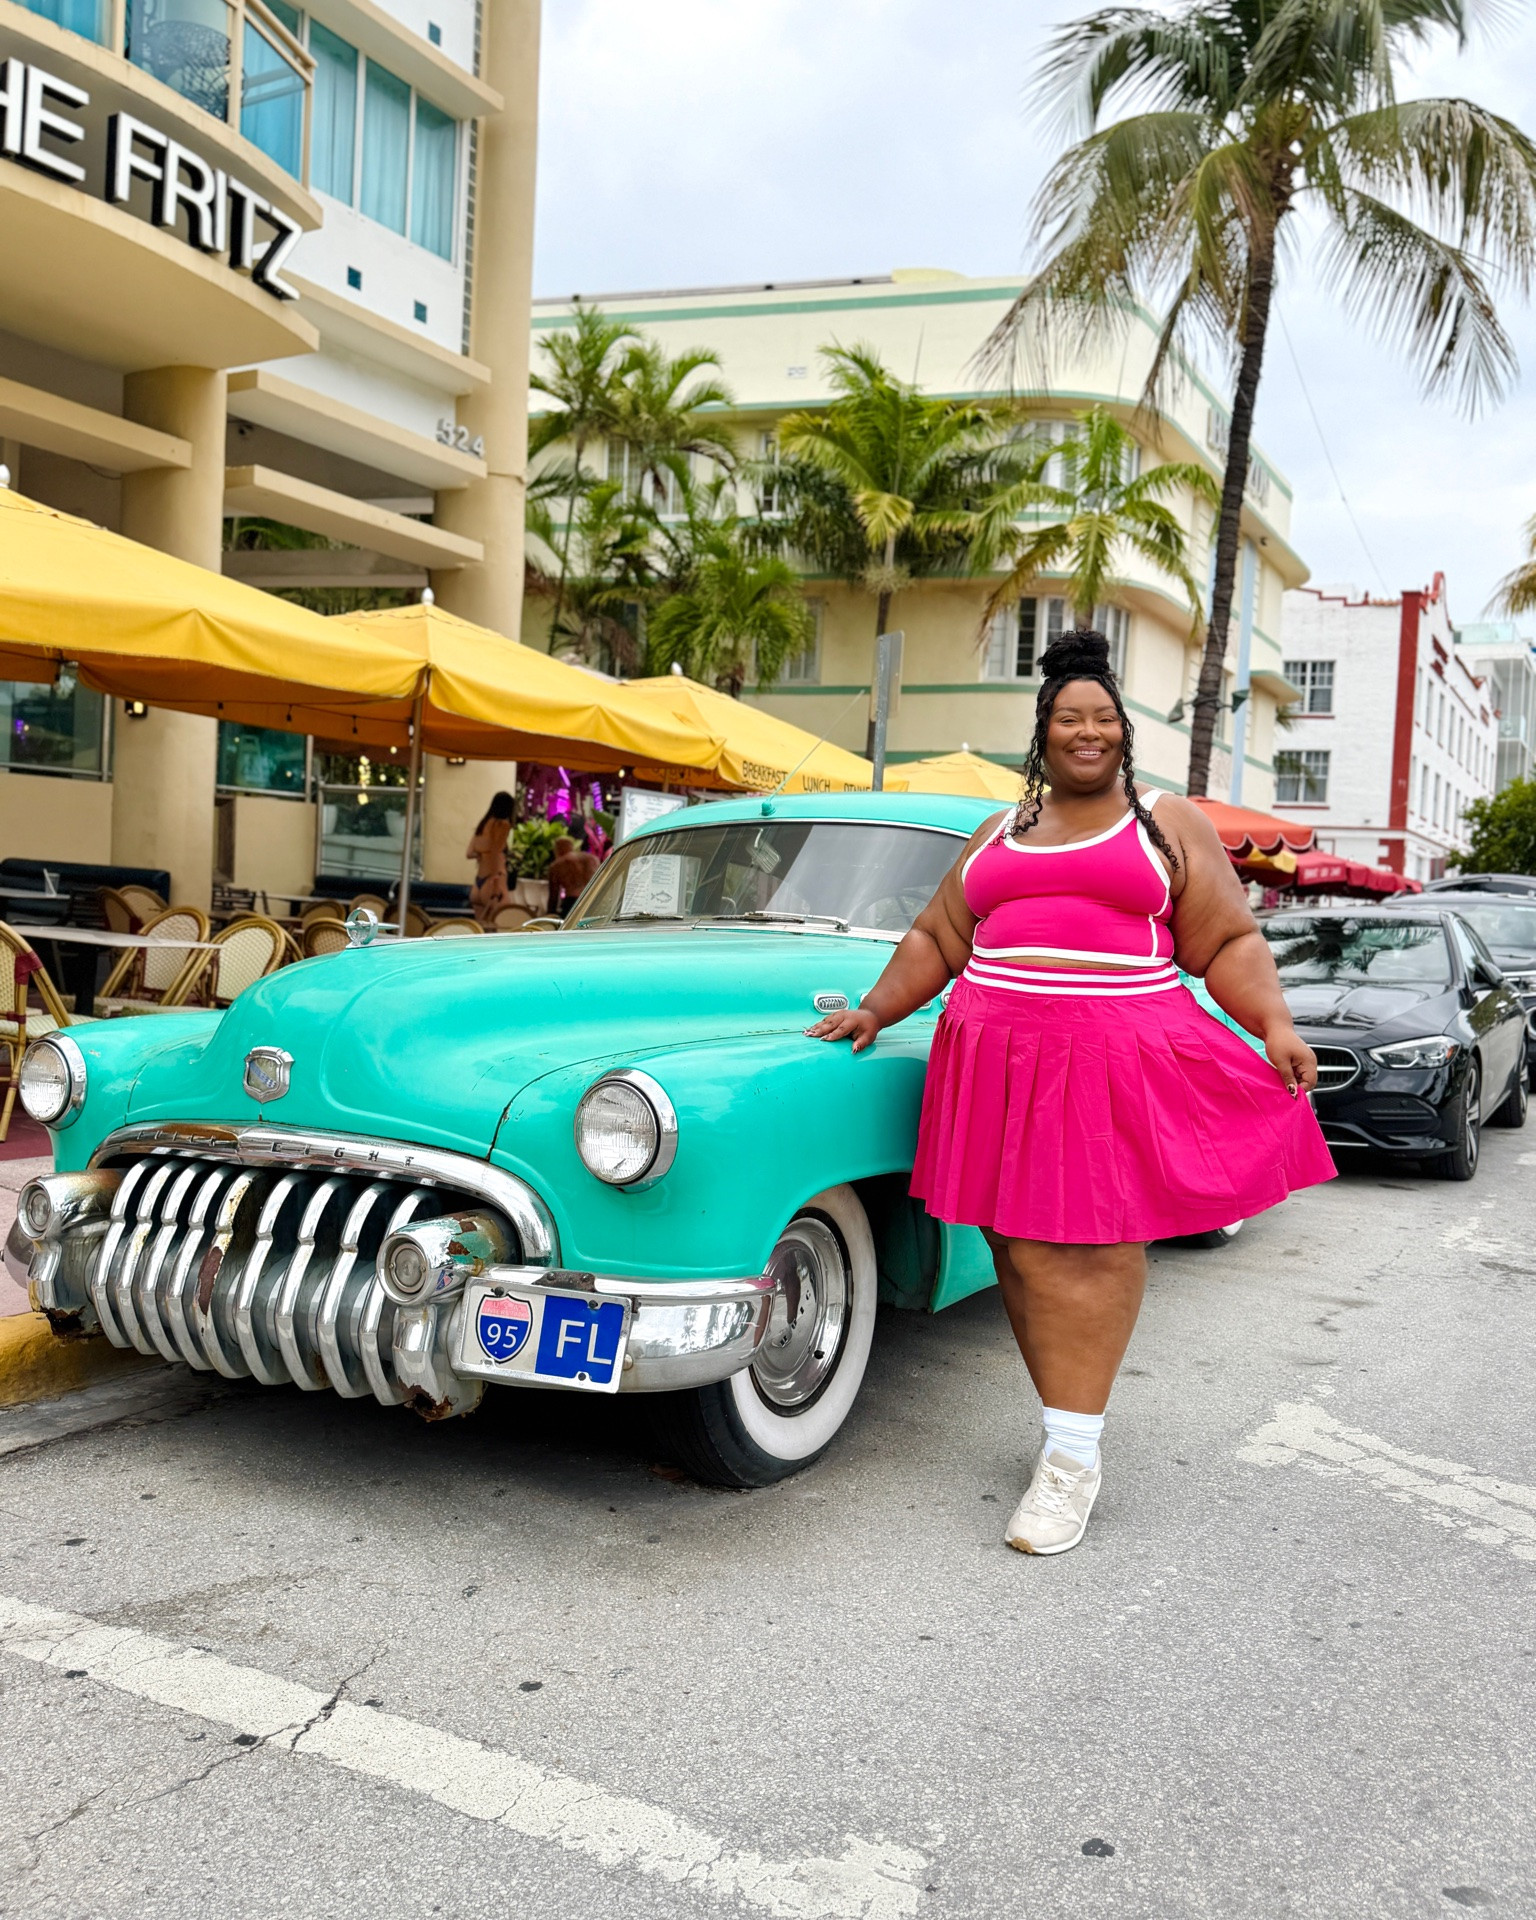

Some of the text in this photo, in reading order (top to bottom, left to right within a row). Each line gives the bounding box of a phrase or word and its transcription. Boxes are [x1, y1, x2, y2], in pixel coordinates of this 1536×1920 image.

[108, 111, 303, 300] FRITZ
[436, 418, 485, 459] 524
[742, 760, 788, 785] BREAKFAST
[802, 775, 831, 793] LUNCH
[271, 1142, 414, 1167] EIGHT
[486, 1323, 519, 1349] 95
[555, 1318, 612, 1366] FL
